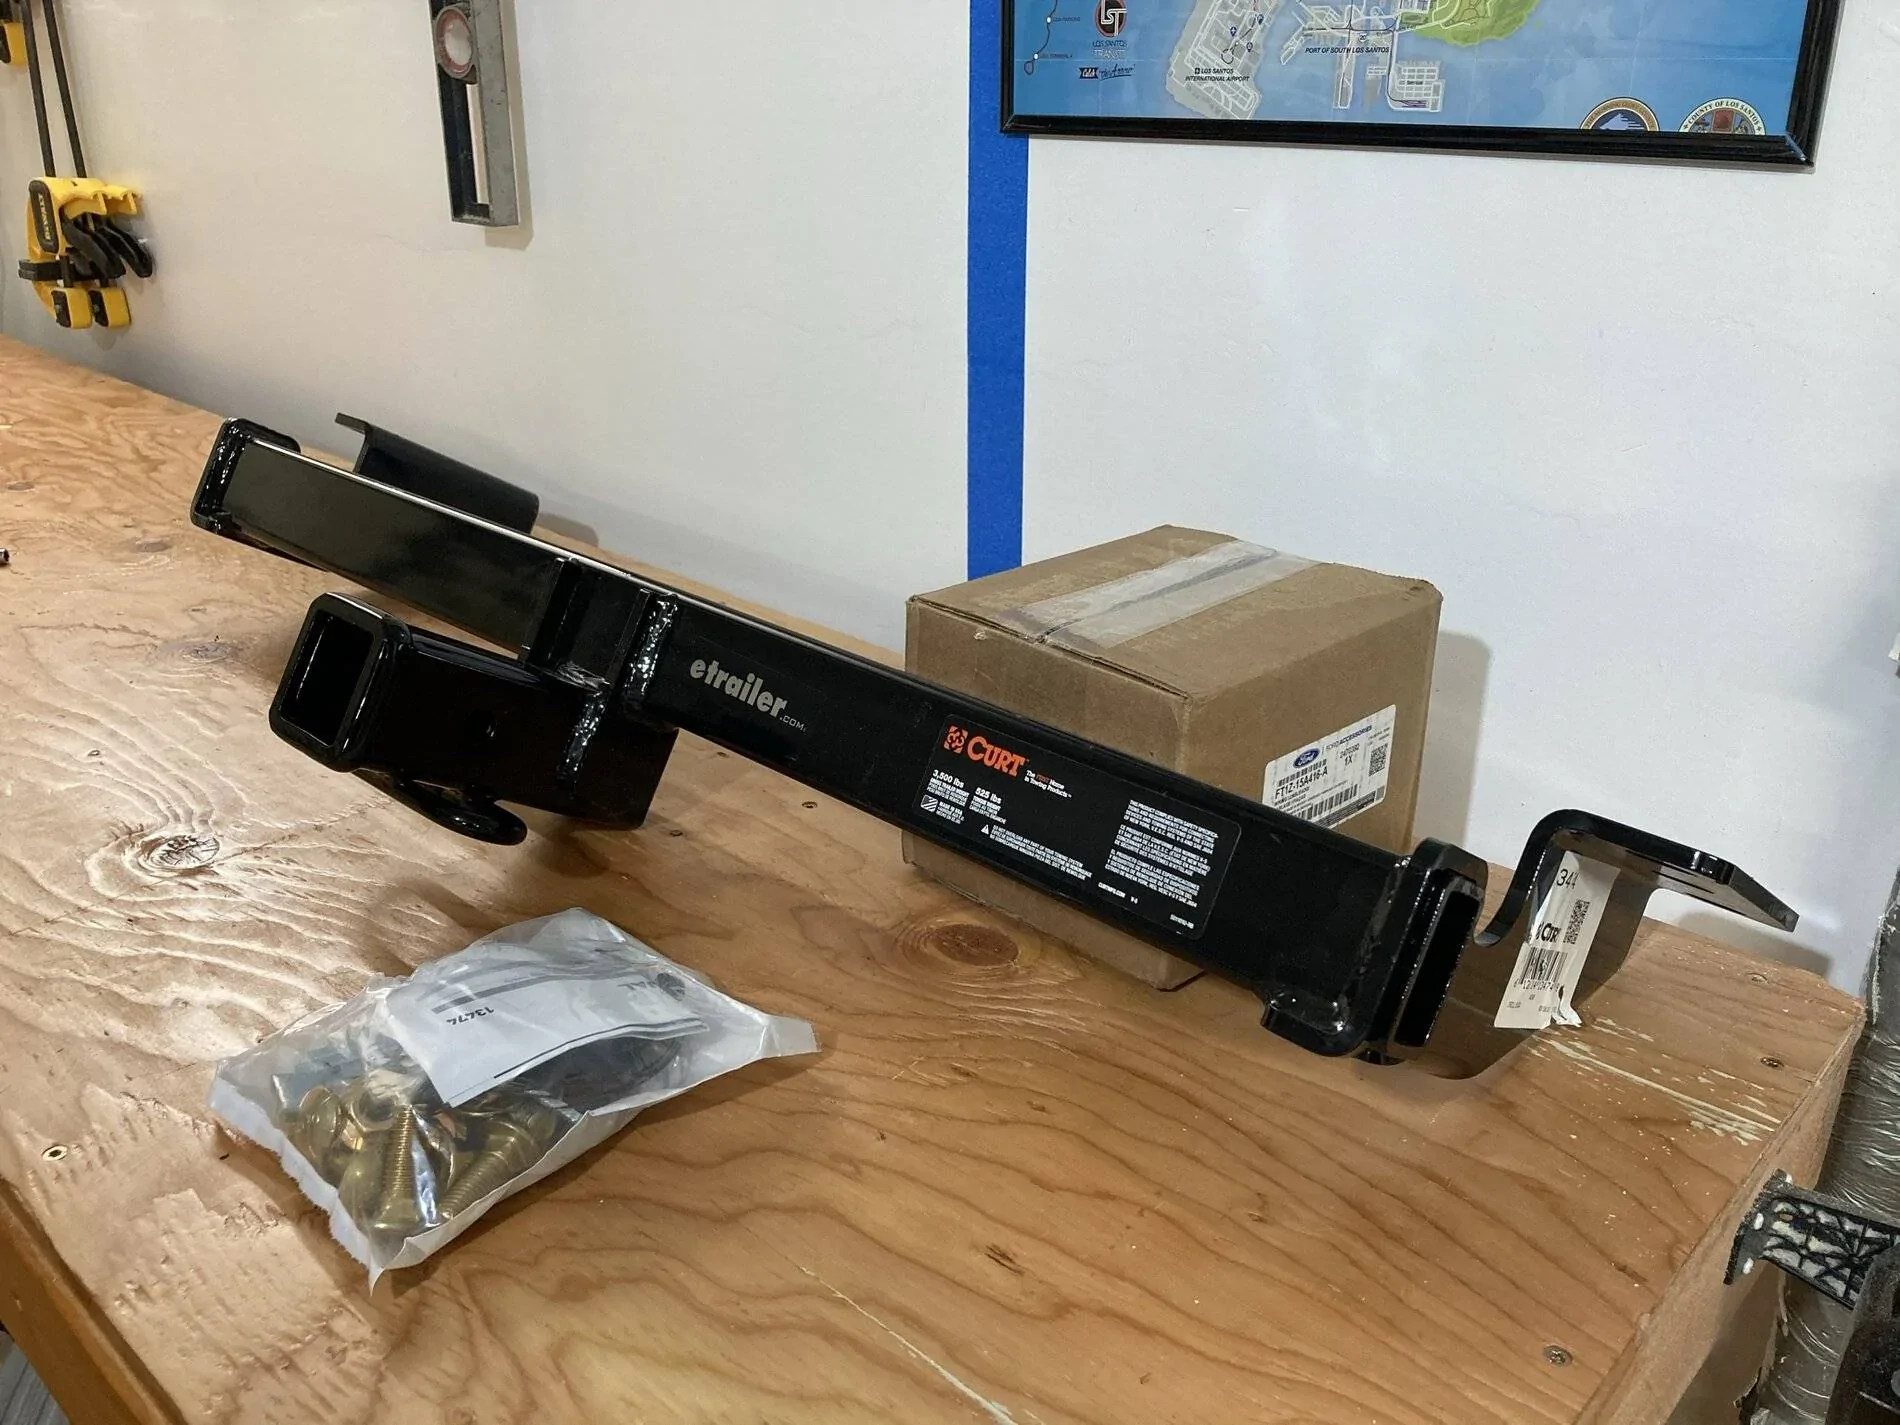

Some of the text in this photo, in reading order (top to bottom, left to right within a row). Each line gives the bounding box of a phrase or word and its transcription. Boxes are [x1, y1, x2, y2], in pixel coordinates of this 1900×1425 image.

[1688, 104, 1713, 125] COUNTY
[1725, 100, 1740, 108] LOS
[967, 736, 1026, 778] CURT
[933, 769, 965, 788] 3,500 lbs
[975, 787, 991, 799] 525
[990, 793, 1003, 804] lbs
